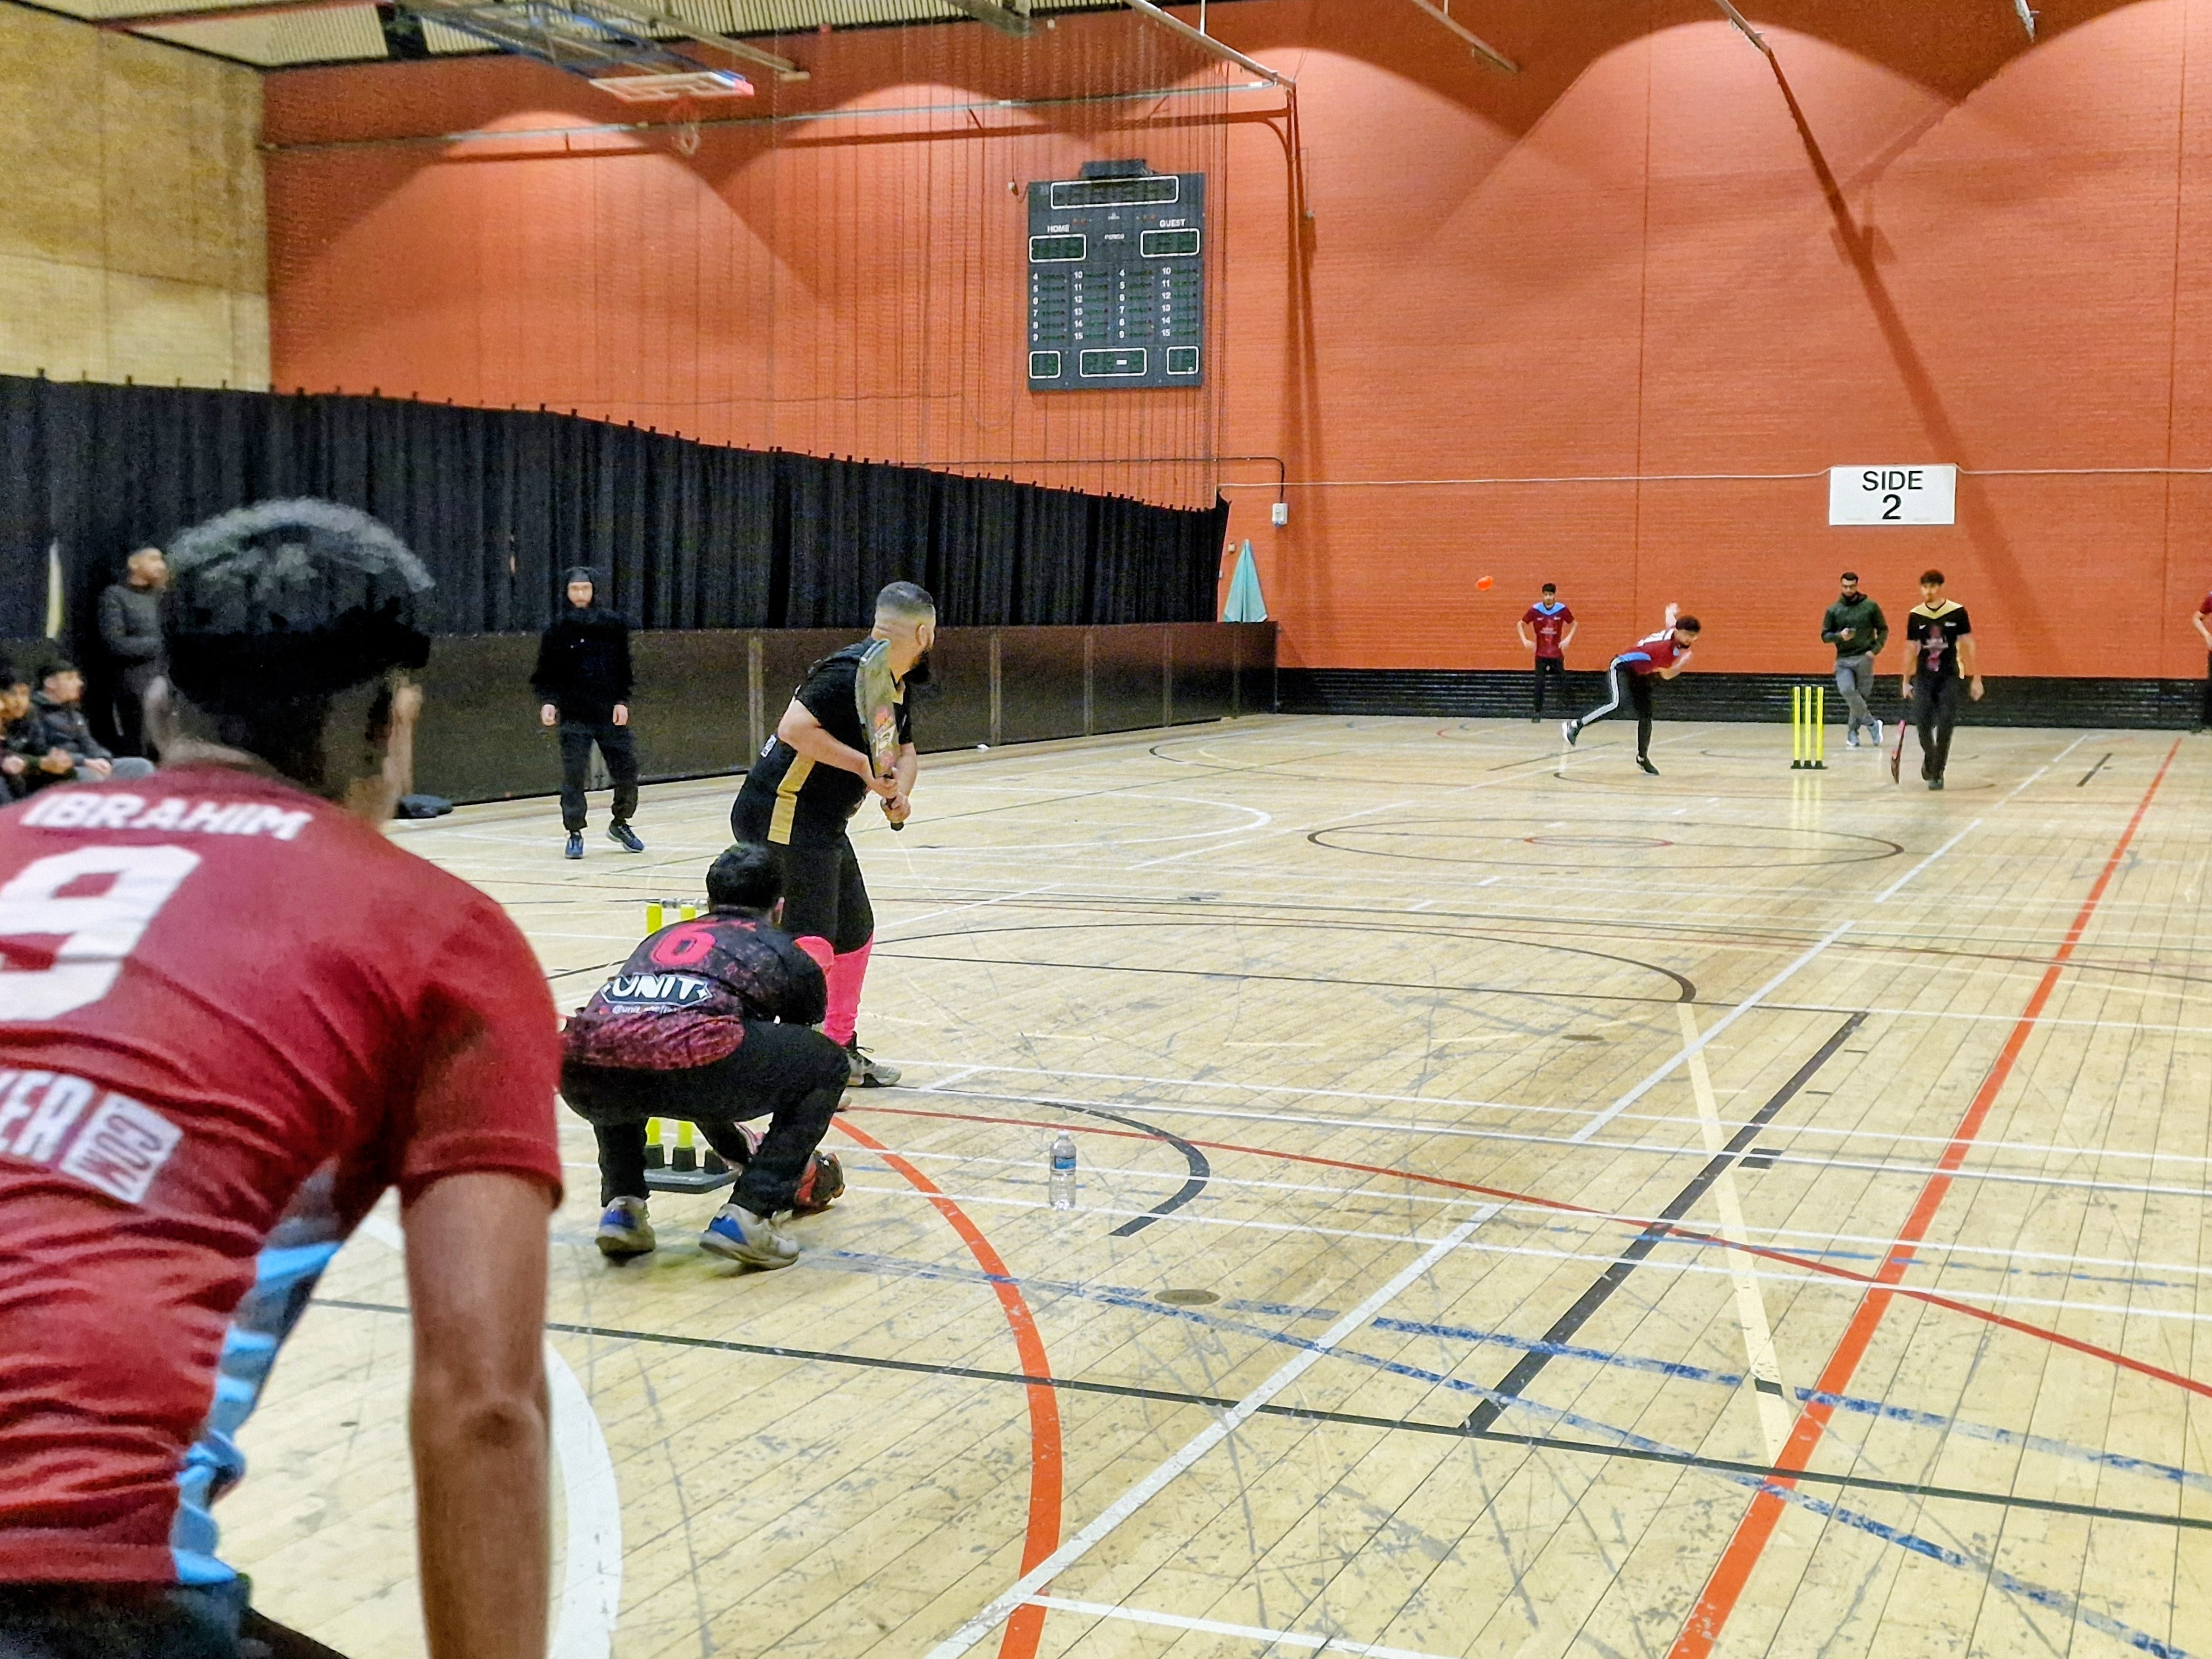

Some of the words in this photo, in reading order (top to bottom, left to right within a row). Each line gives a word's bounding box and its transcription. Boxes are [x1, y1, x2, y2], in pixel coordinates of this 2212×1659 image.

[1159, 219, 1186, 228] GUEST
[1047, 224, 1070, 233] HOME
[1073, 271, 1083, 279] 10
[1119, 269, 1125, 277] 4
[1161, 267, 1171, 275] 10
[1073, 283, 1082, 291] 11
[1161, 279, 1170, 287] 11
[1073, 295, 1083, 303] 12
[1033, 309, 1038, 317] 7
[1119, 306, 1125, 314] 7
[1161, 316, 1171, 324] 14
[1073, 332, 1083, 340] 15
[1161, 328, 1171, 337] 15
[1862, 470, 1924, 491] SIDE
[1881, 493, 1902, 520] 2
[19, 792, 314, 841] IBRAHIM
[0, 845, 202, 1021] 9
[650, 921, 718, 967] 6
[611, 975, 705, 1000] UNIT
[0, 1068, 95, 1163] ER
